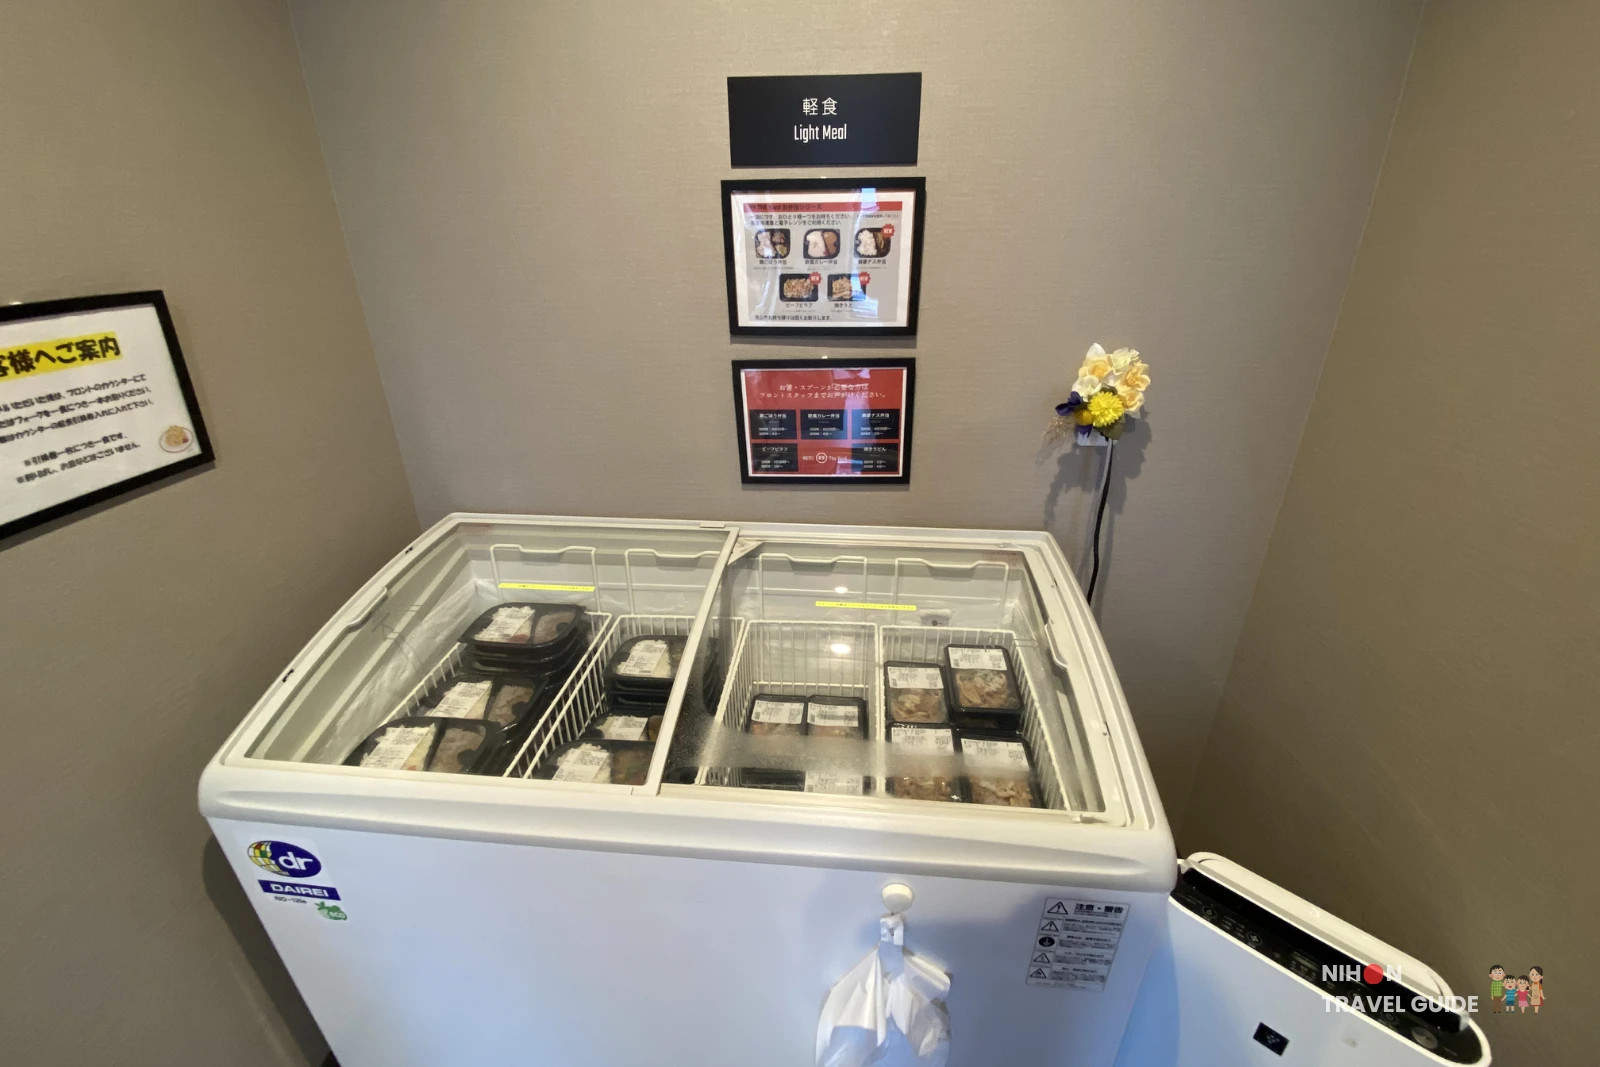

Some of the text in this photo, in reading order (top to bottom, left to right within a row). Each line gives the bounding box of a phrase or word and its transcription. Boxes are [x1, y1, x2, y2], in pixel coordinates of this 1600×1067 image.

[802, 97, 838, 116] 軽食
[794, 123, 847, 144] Light Meal
[278, 851, 314, 871] dr
[269, 883, 329, 898] DAIREI
[1074, 903, 1124, 914] 注意・警告
